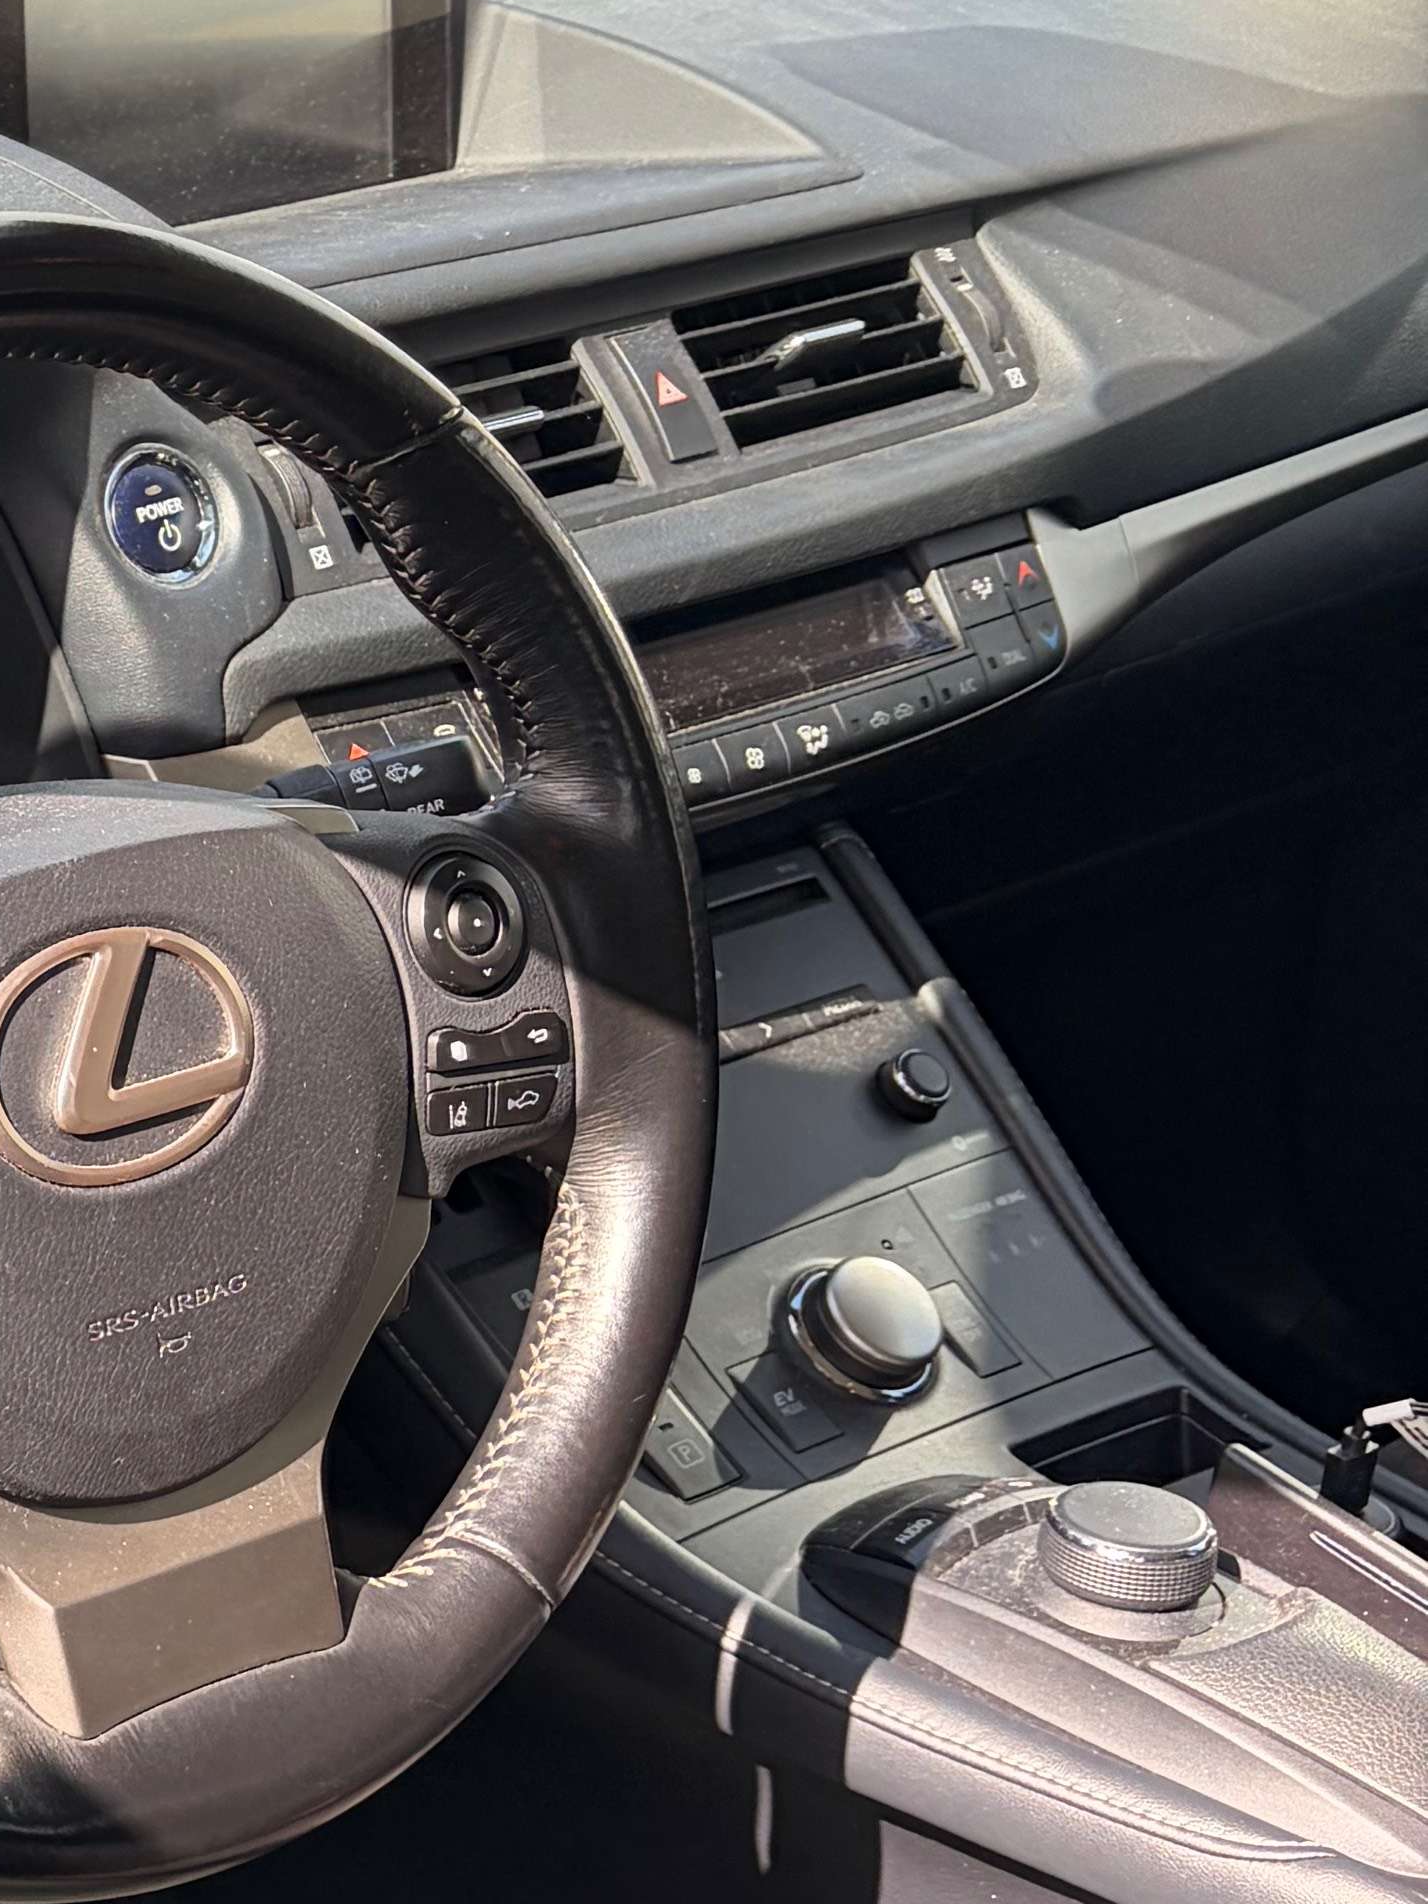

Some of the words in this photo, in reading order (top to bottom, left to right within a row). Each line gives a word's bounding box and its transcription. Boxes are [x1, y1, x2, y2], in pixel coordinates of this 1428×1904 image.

[135, 496, 185, 524] POWER
[87, 1273, 248, 1342] SRS-AIRBAG
[773, 1387, 794, 1407] EV
